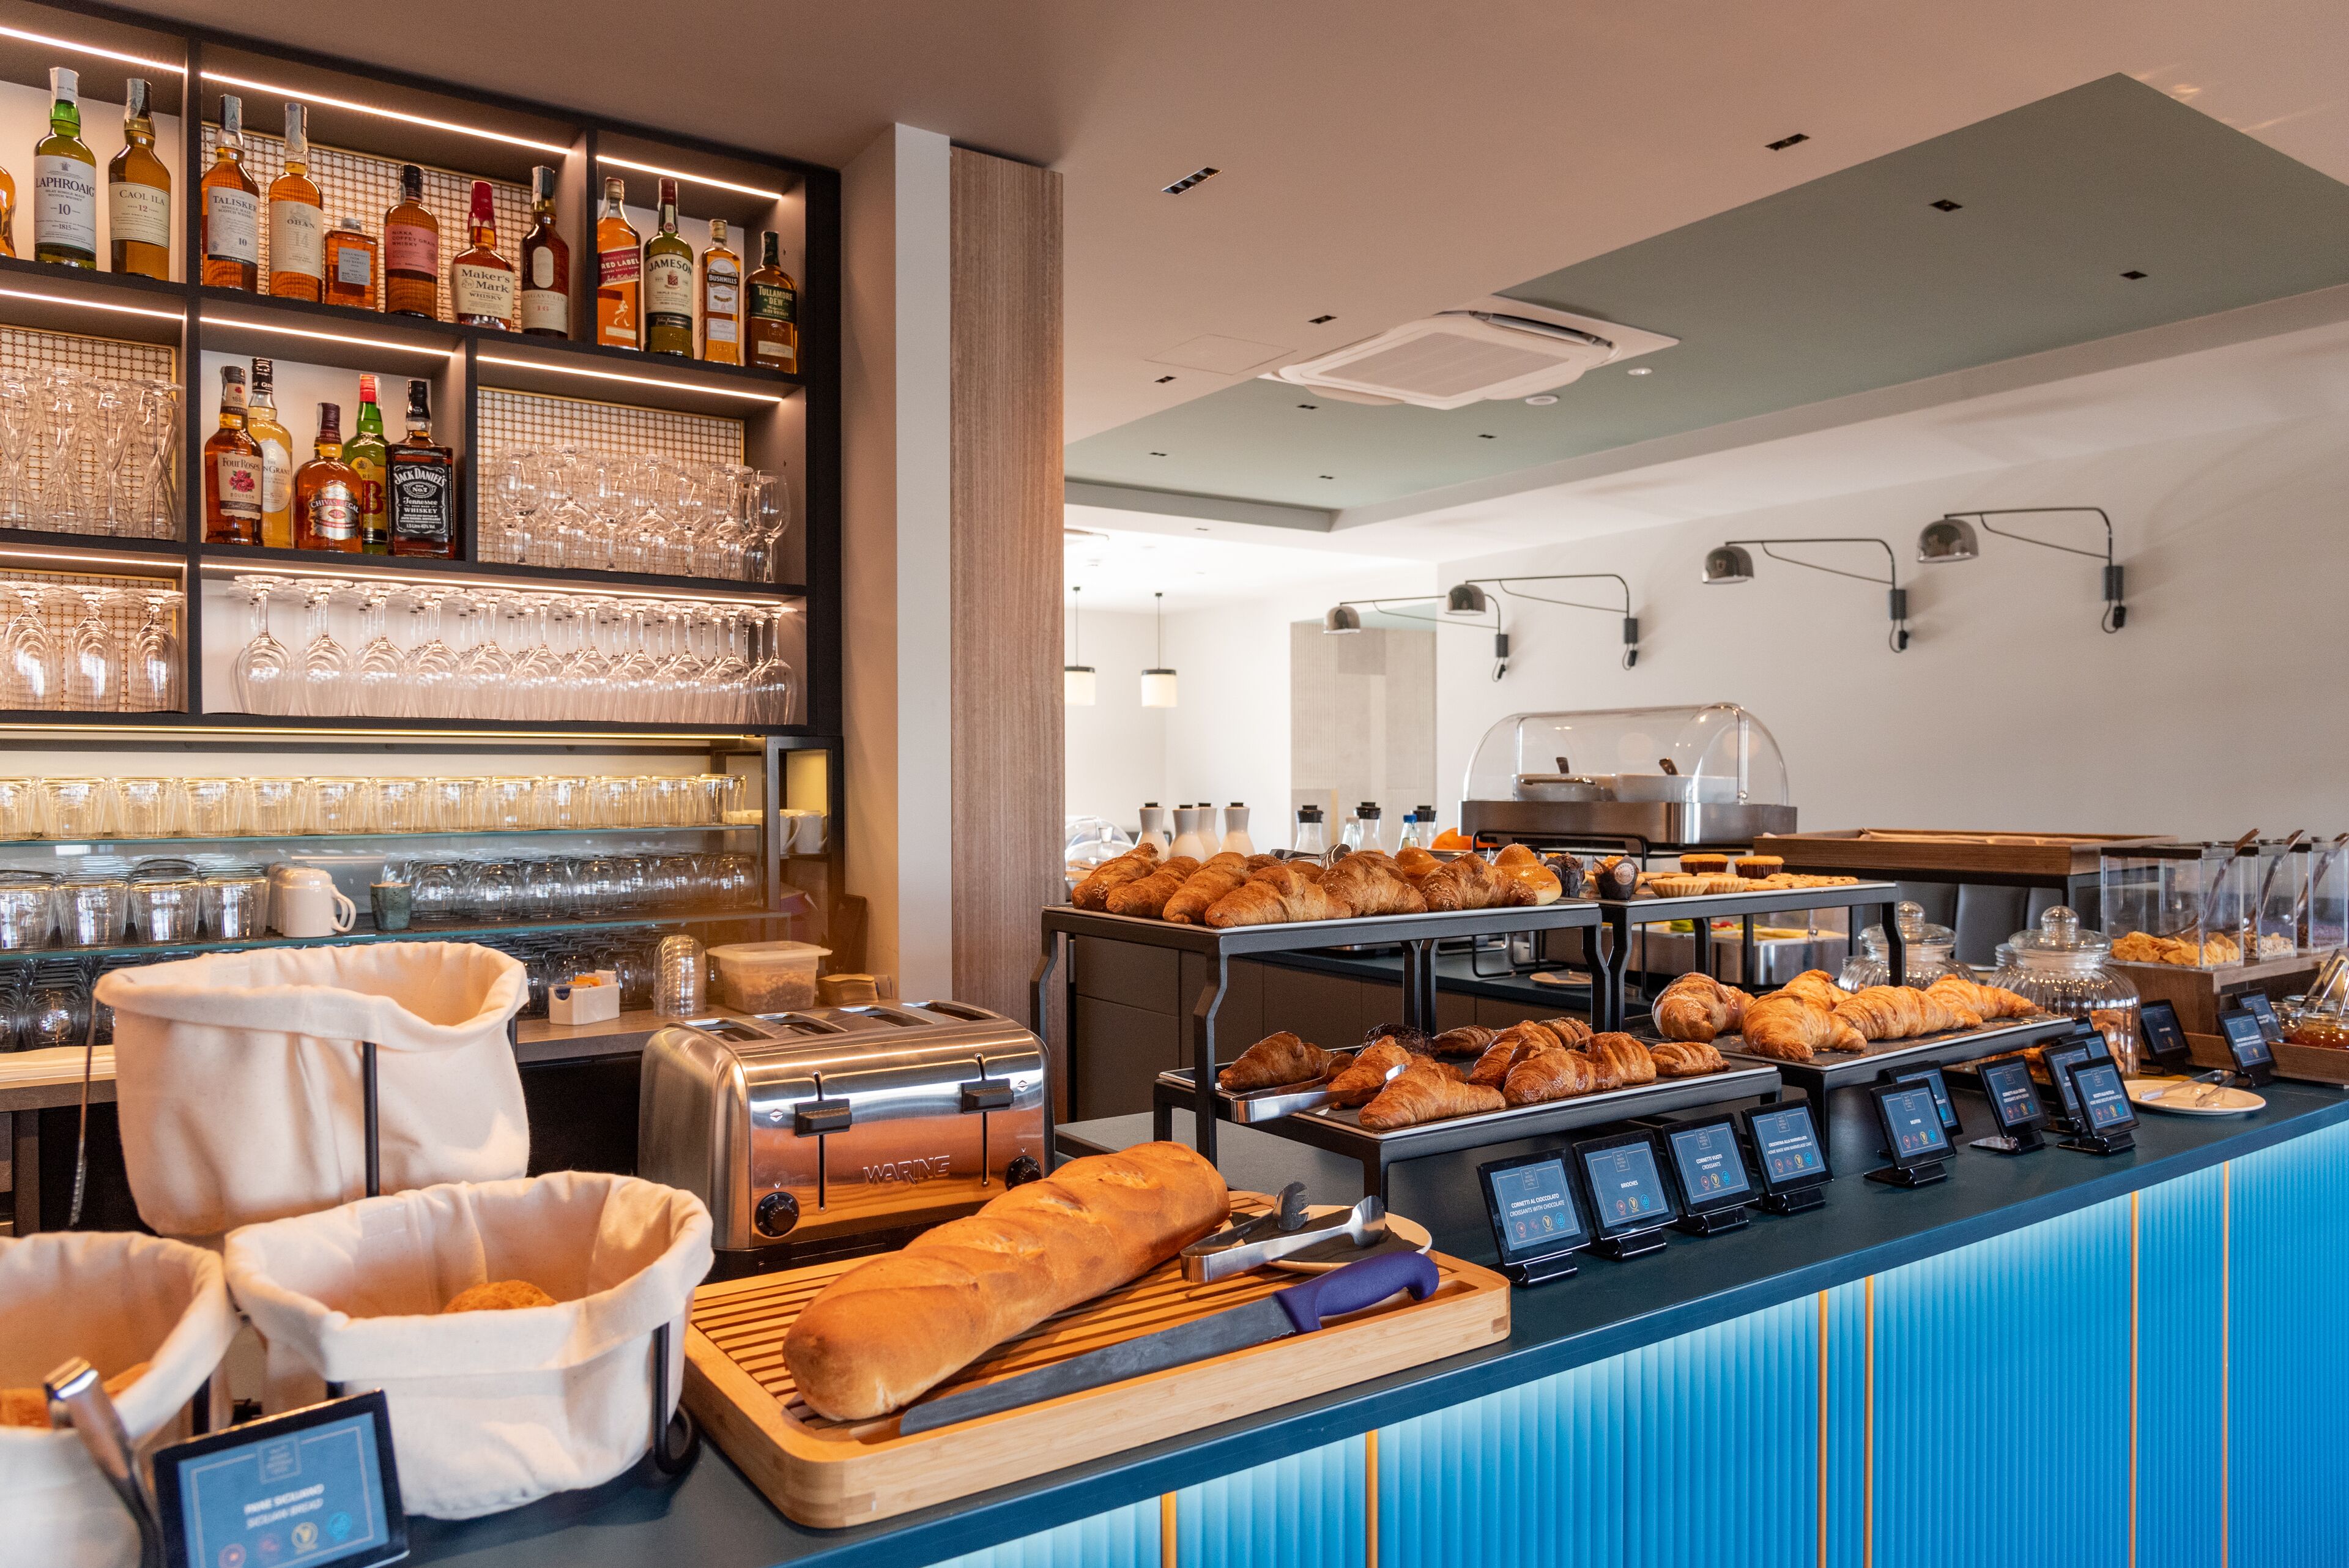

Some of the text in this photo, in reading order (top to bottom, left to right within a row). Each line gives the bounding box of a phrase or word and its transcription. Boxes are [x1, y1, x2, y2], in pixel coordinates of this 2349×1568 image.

[36, 177, 94, 197] LAPHROAIG
[119, 189, 165, 206] CAOL ILA
[213, 196, 257, 212] TALISKER
[58, 203, 71, 215] 10
[287, 218, 314, 229] OBAN
[239, 237, 247, 247] 10
[617, 258, 640, 267] LABEL
[649, 259, 692, 276] JAMESON
[461, 269, 510, 284] Maker's
[708, 274, 738, 285] BUSHMILLS
[476, 280, 510, 294] Mark
[757, 285, 793, 301] TULLAMORE
[469, 292, 503, 300] WHISKY
[768, 297, 783, 307] DEW
[223, 456, 260, 471] Four Roses
[393, 467, 447, 487] JACK DANIEL'S
[310, 499, 359, 514] CHIVAS REGAL
[403, 497, 438, 505] Tennessee
[863, 1155, 950, 1186] WARING
[1702, 1161, 1721, 1170] CROISSANTS
[1620, 1180, 1639, 1189] BRIOCHES
[1511, 1199, 1531, 1208] CORNETTI
[1535, 1193, 1559, 1203] CIOCCOLATO
[1510, 1207, 1533, 1217] CROISSANTS
[1543, 1200, 1565, 1209] CHOCOLATE
